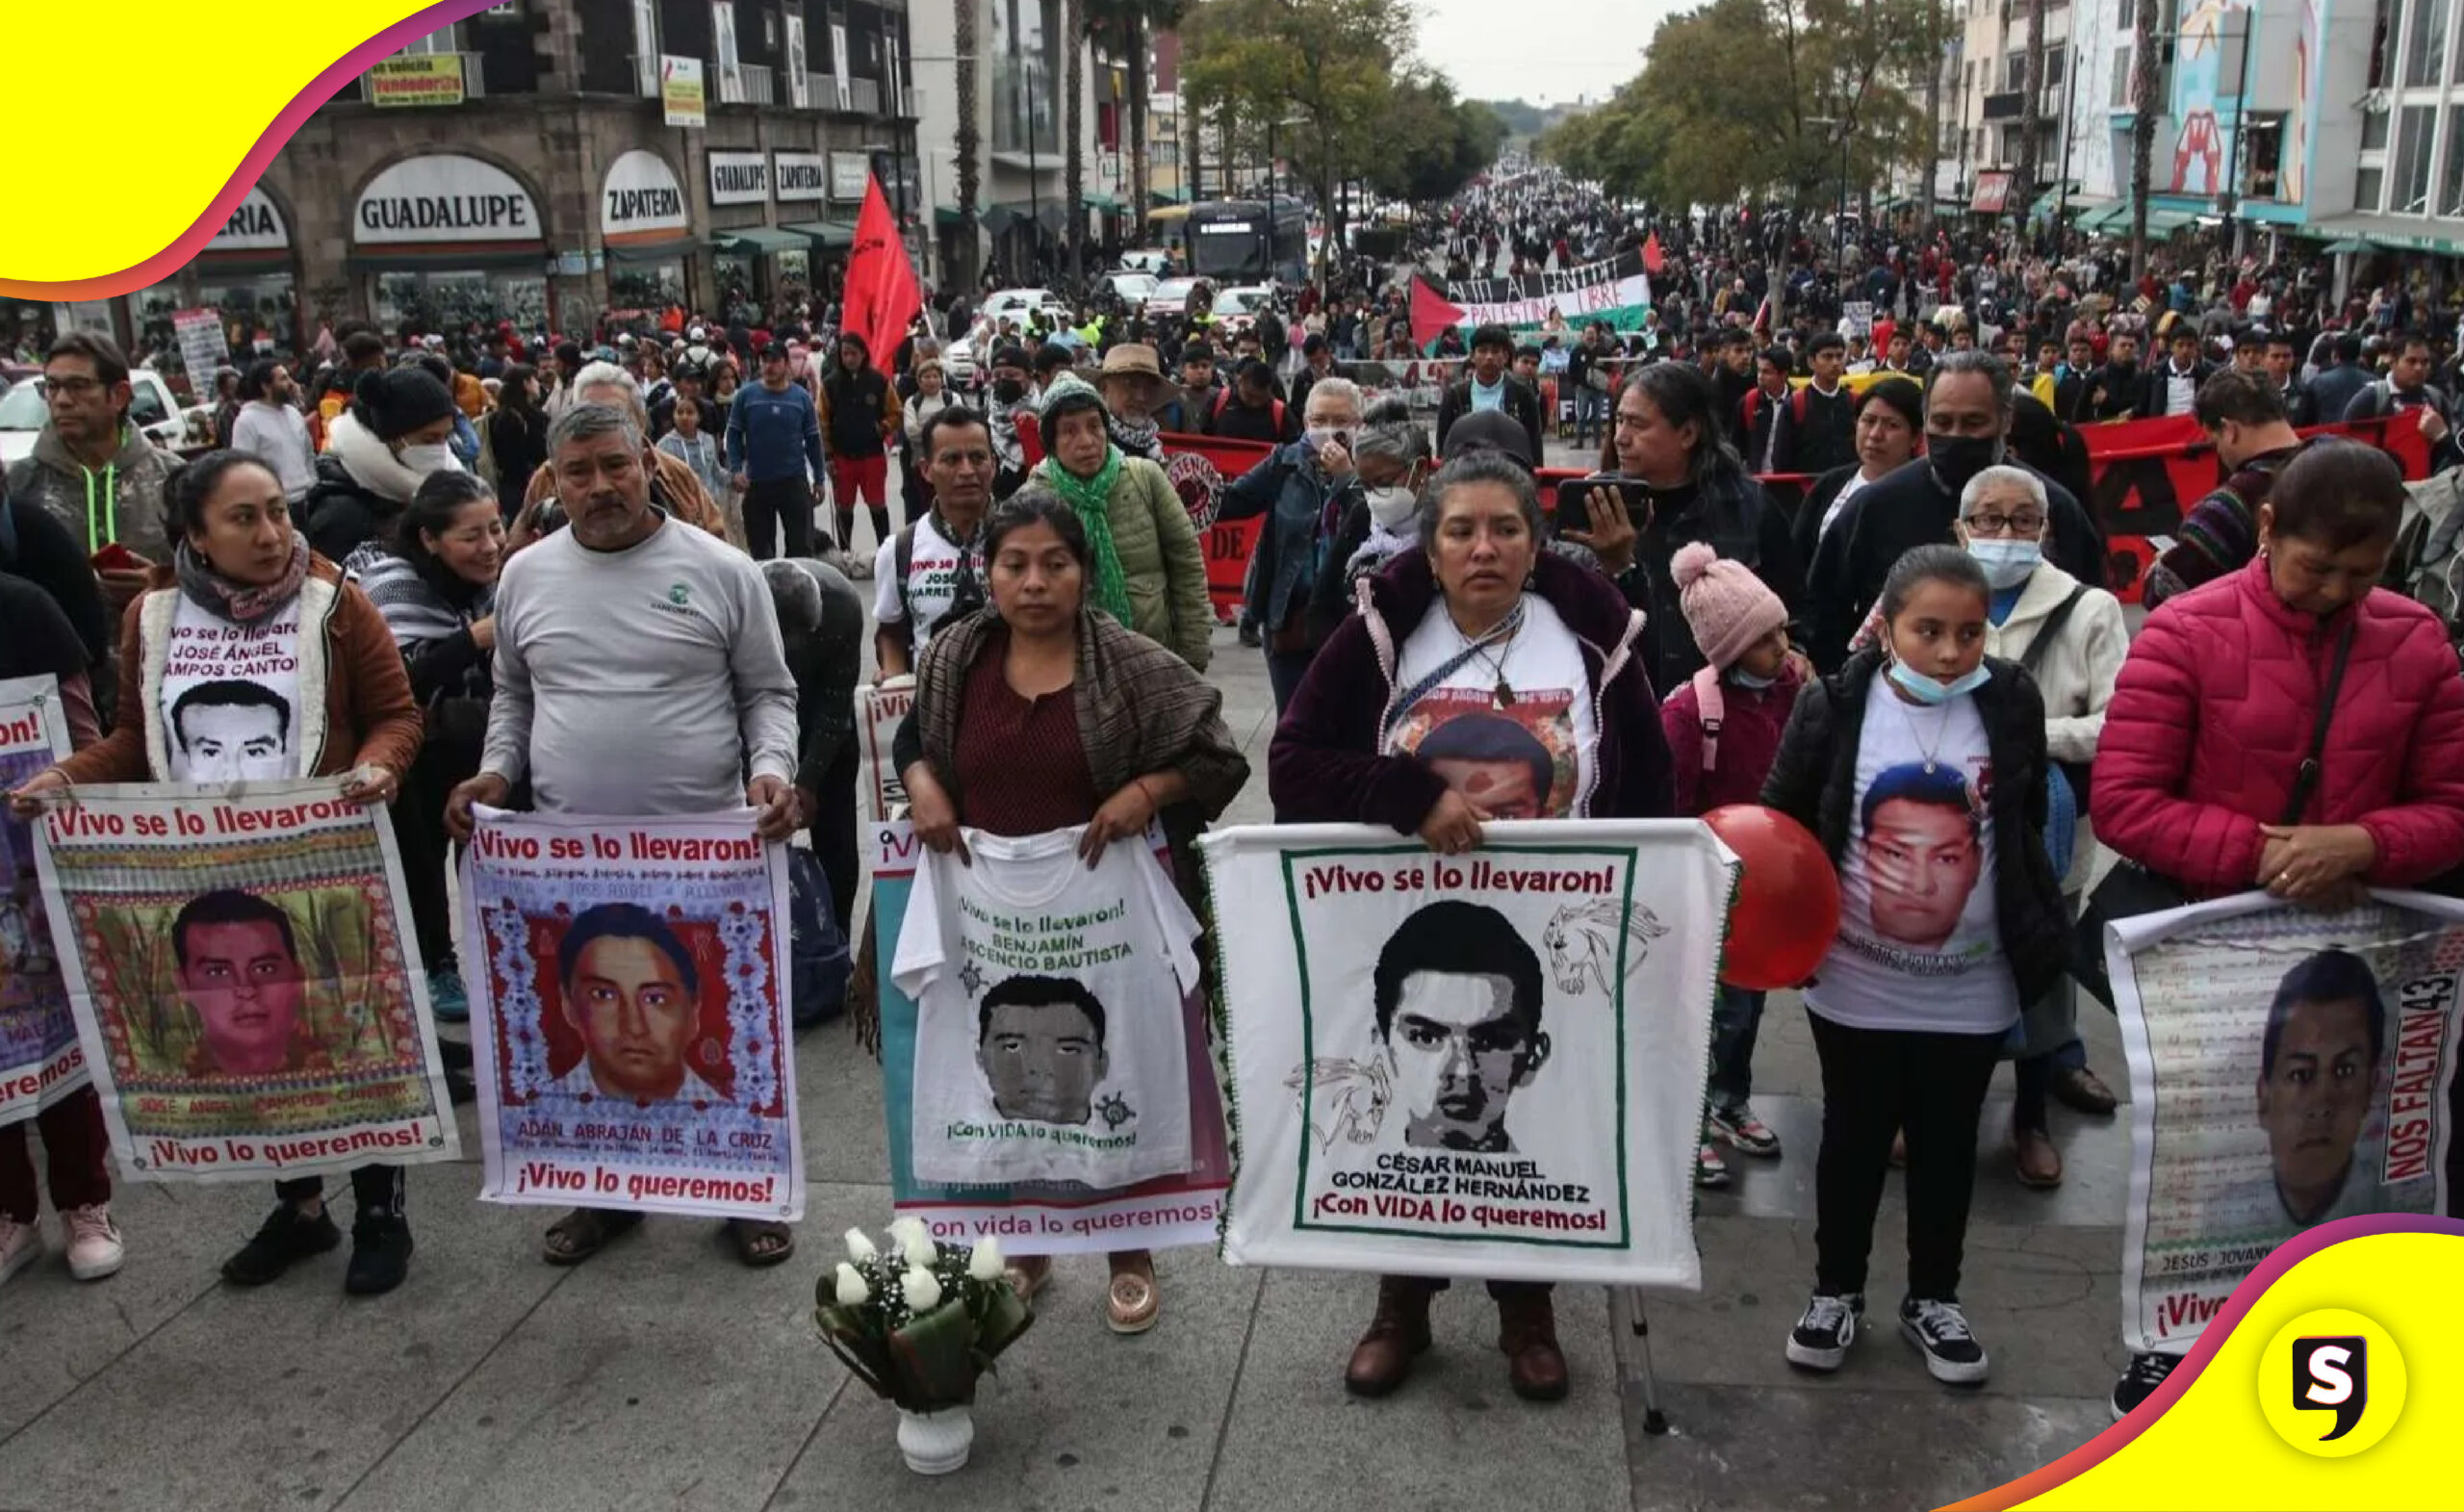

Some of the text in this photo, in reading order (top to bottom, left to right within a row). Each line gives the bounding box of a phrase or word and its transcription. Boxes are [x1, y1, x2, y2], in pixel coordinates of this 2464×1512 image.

[713, 163, 767, 192] GUADALUPE
[361, 193, 526, 229] GUADALUPE
[607, 188, 682, 221] ZAPATERIA
[196, 627, 218, 641] se
[221, 626, 239, 643] lo
[163, 656, 299, 677] AMPOS CANTO
[49, 805, 124, 843] ¡Vivo
[132, 813, 168, 836] se
[173, 807, 205, 835] lo
[473, 828, 761, 862] ¡Vivo se lo llevaron!
[1304, 860, 1614, 899] ¡Vivo se lo llevaron!
[992, 915, 1012, 930] se
[1014, 916, 1034, 933] lo
[1039, 897, 1125, 933] llevaron!
[961, 935, 1133, 972] ASCENCIO BAUTISTA
[992, 933, 1084, 955] BENJAMÍN
[2393, 1011, 2445, 1115] FALTAN
[150, 1121, 424, 1168] ¡Vivo lo queremos!
[661, 1128, 683, 1145] DE
[696, 1130, 718, 1147] LA
[728, 1131, 772, 1151] CRUZ
[947, 1122, 1138, 1149] ¡Con VIDA lo queremos!
[2386, 1118, 2430, 1180] NOS
[517, 1162, 775, 1203] ¡Vivo lo queremos!
[1376, 1152, 1547, 1180] CÉSAR MANUEL
[1331, 1170, 1591, 1203] GONZÁLEZ HERNÁNDEZ
[920, 1198, 1221, 1242] on vida lo queremos!
[1313, 1192, 1607, 1231] ¡Con VIDA lo queremos!
